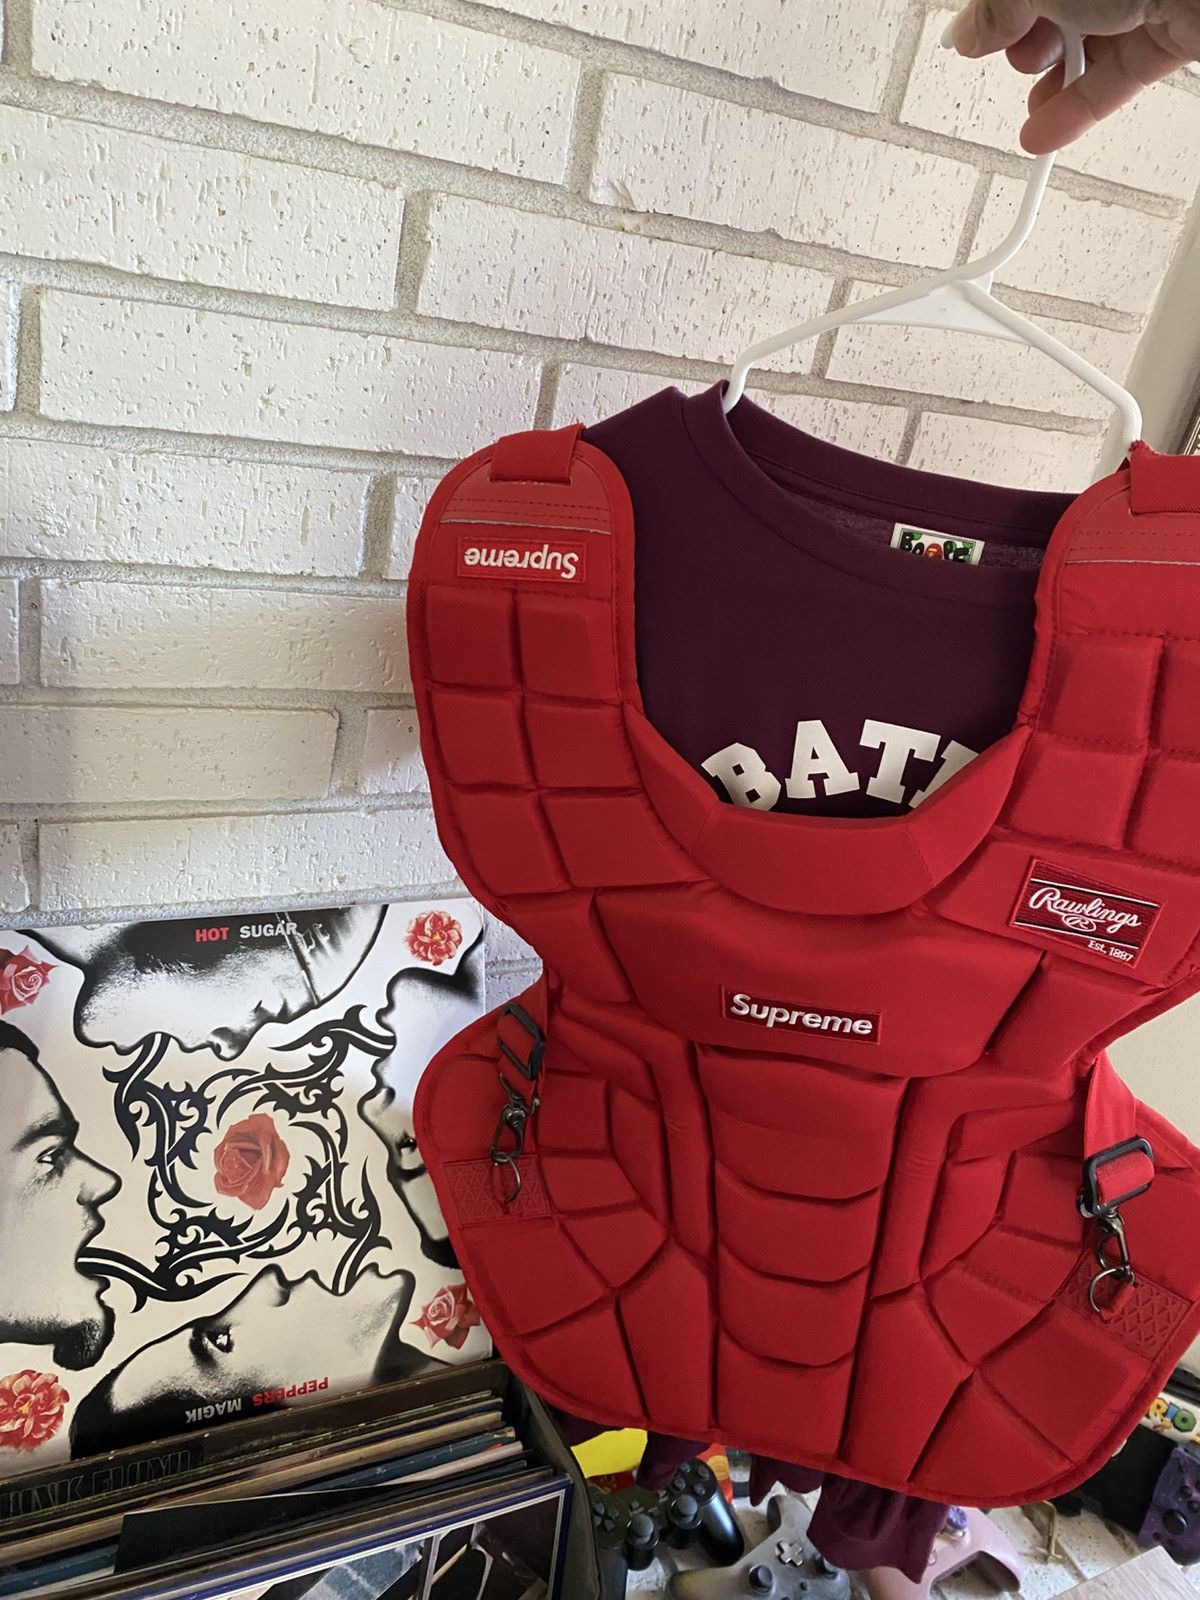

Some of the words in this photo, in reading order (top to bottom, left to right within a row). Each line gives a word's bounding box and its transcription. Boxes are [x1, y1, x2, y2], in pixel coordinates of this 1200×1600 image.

[463, 543, 580, 580] Supreme
[1028, 886, 1142, 934] Rawlings
[195, 926, 230, 943] HOT
[239, 922, 298, 939] SUGAR
[1087, 939, 1107, 954] Est.
[1109, 946, 1134, 962] 1887
[729, 993, 874, 1036] Supreme
[252, 1376, 330, 1407] PEPPERS
[184, 1398, 243, 1424] MAGIK
[1145, 1397, 1197, 1433] RIO
[0, 1475, 85, 1518] INK
